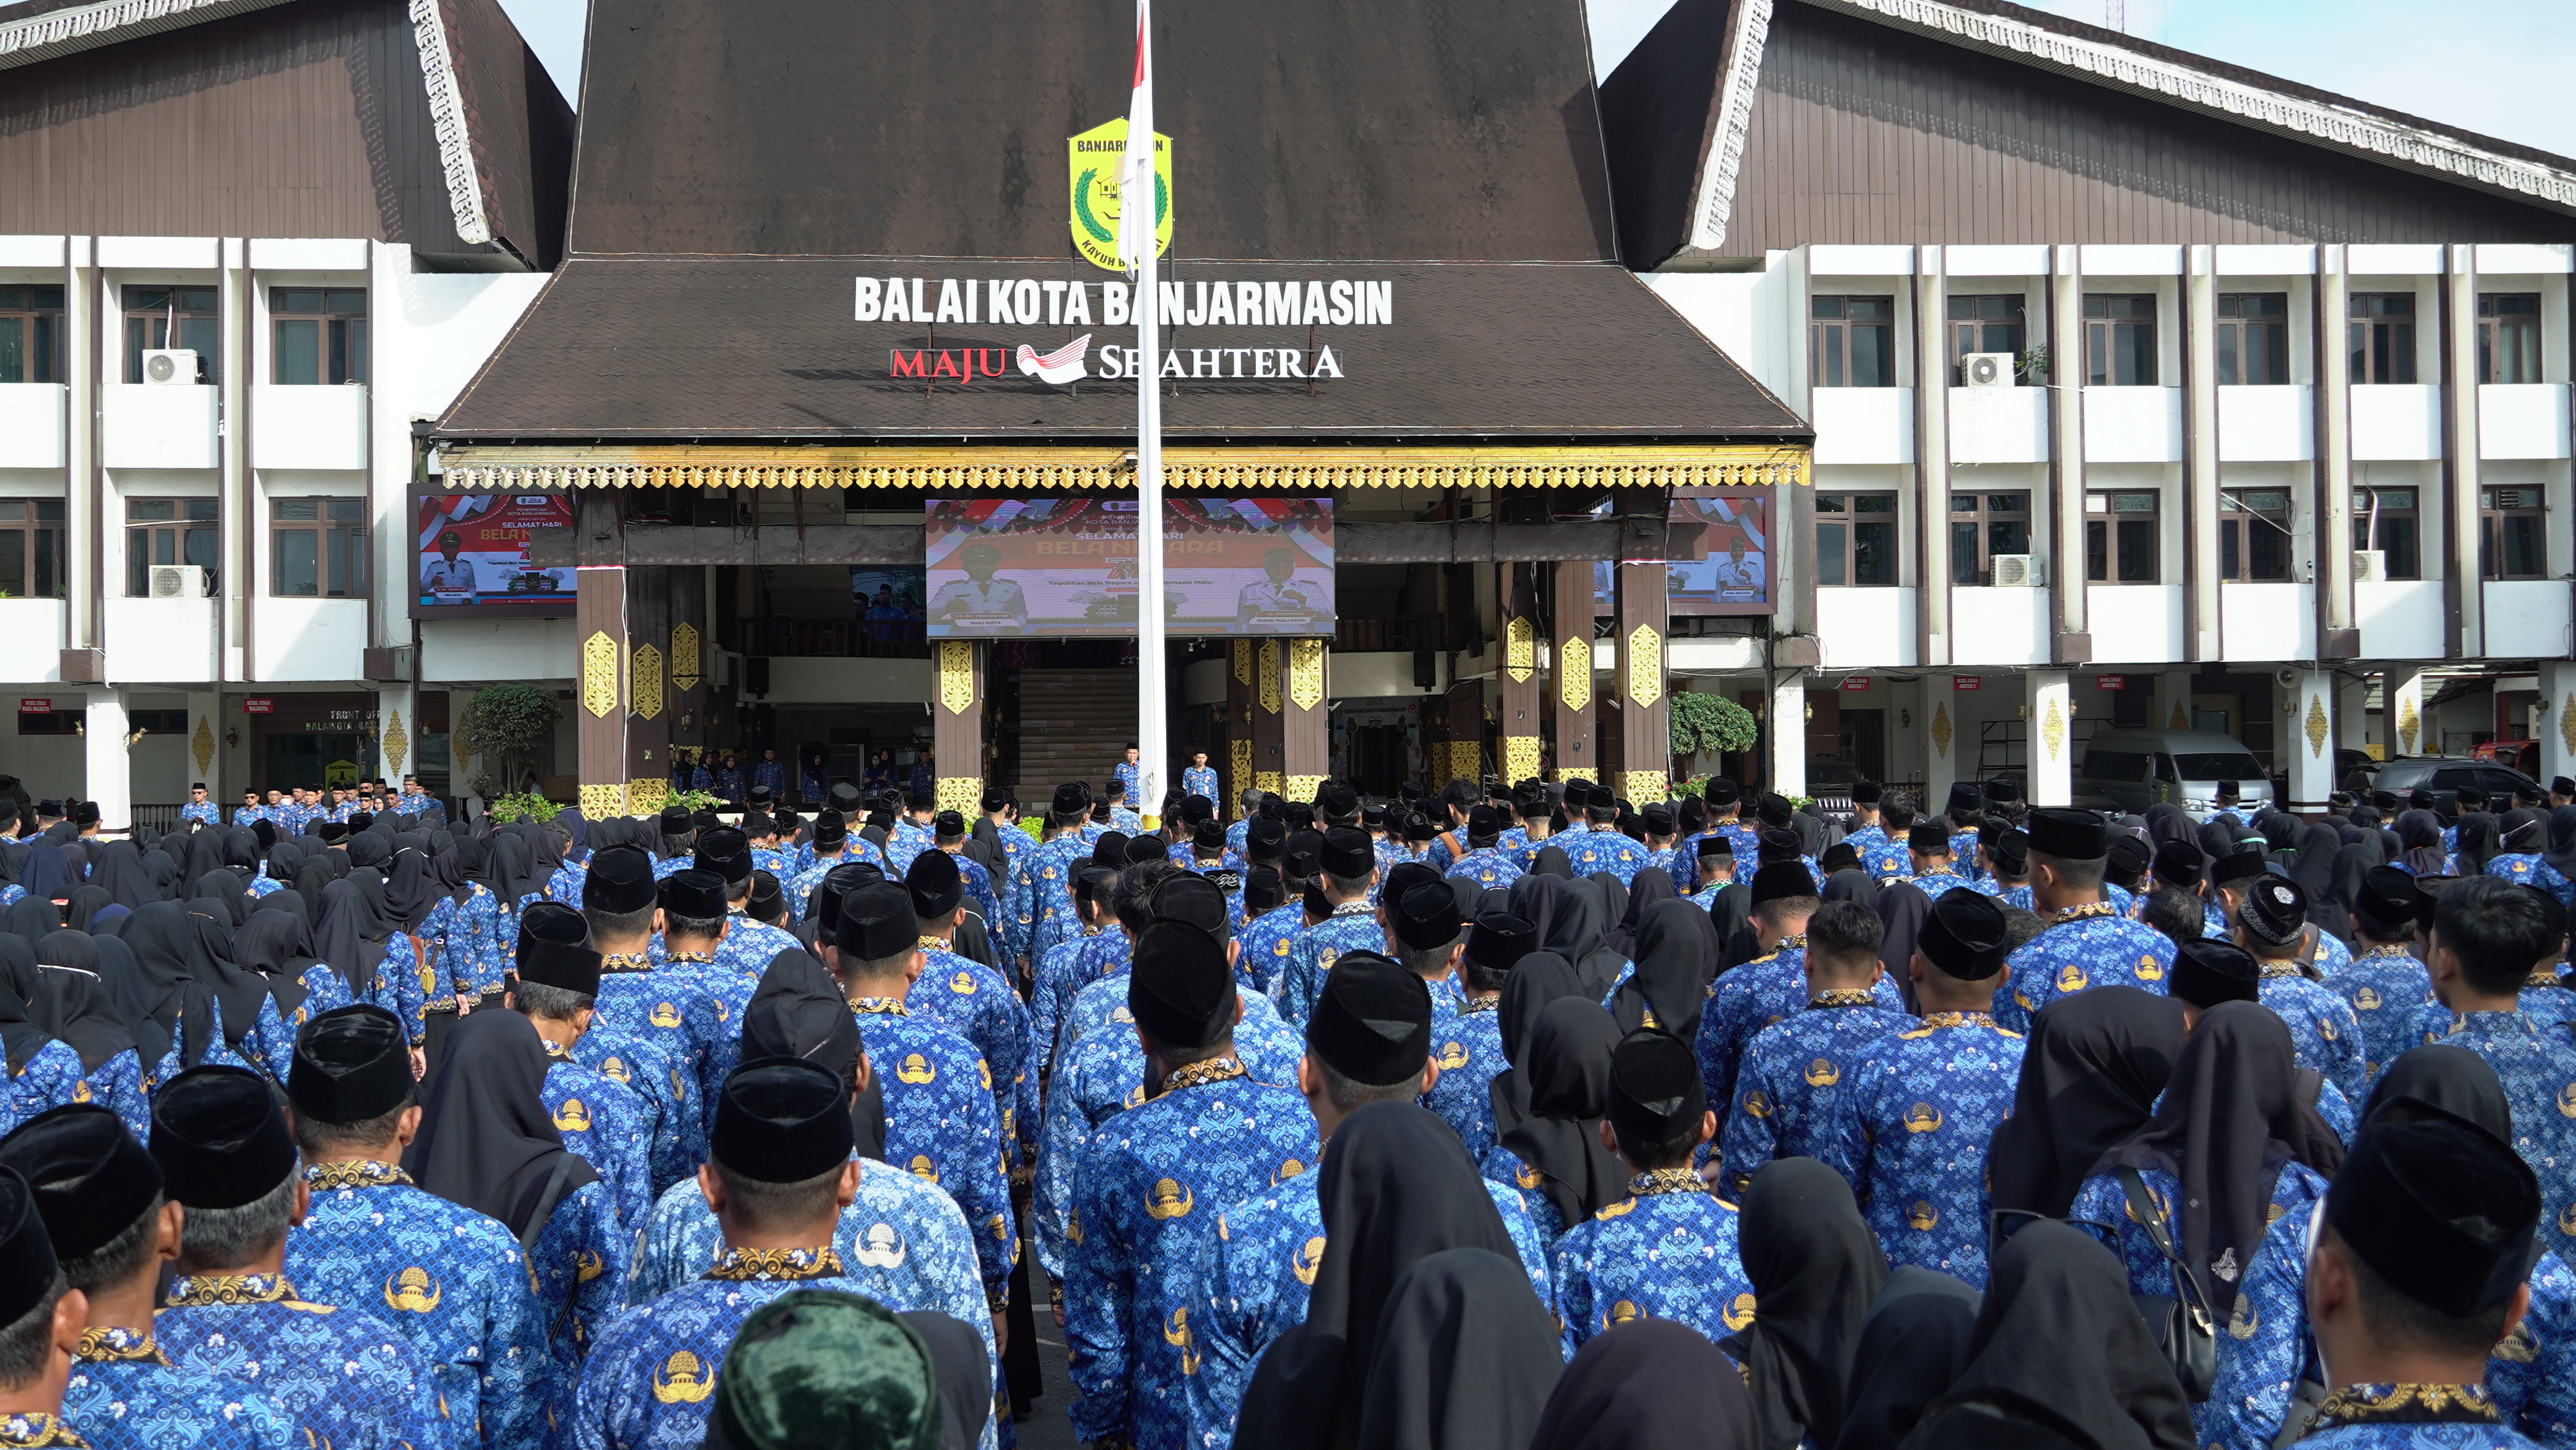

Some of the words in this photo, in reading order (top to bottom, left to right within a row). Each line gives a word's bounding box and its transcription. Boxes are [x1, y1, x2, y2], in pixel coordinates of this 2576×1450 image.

[1078, 140, 1162, 152] BANJARN
[1082, 239, 1115, 266] KAYUH
[855, 277, 977, 323] BALAI
[989, 279, 1092, 325] KOTA
[890, 348, 1007, 385] MAJU
[1099, 345, 1344, 379] SEAHTERA
[481, 529, 518, 540] BELA
[1037, 541, 1104, 555] BELA
[1112, 540, 1223, 555] NARA
[331, 711, 360, 720] FRONT
